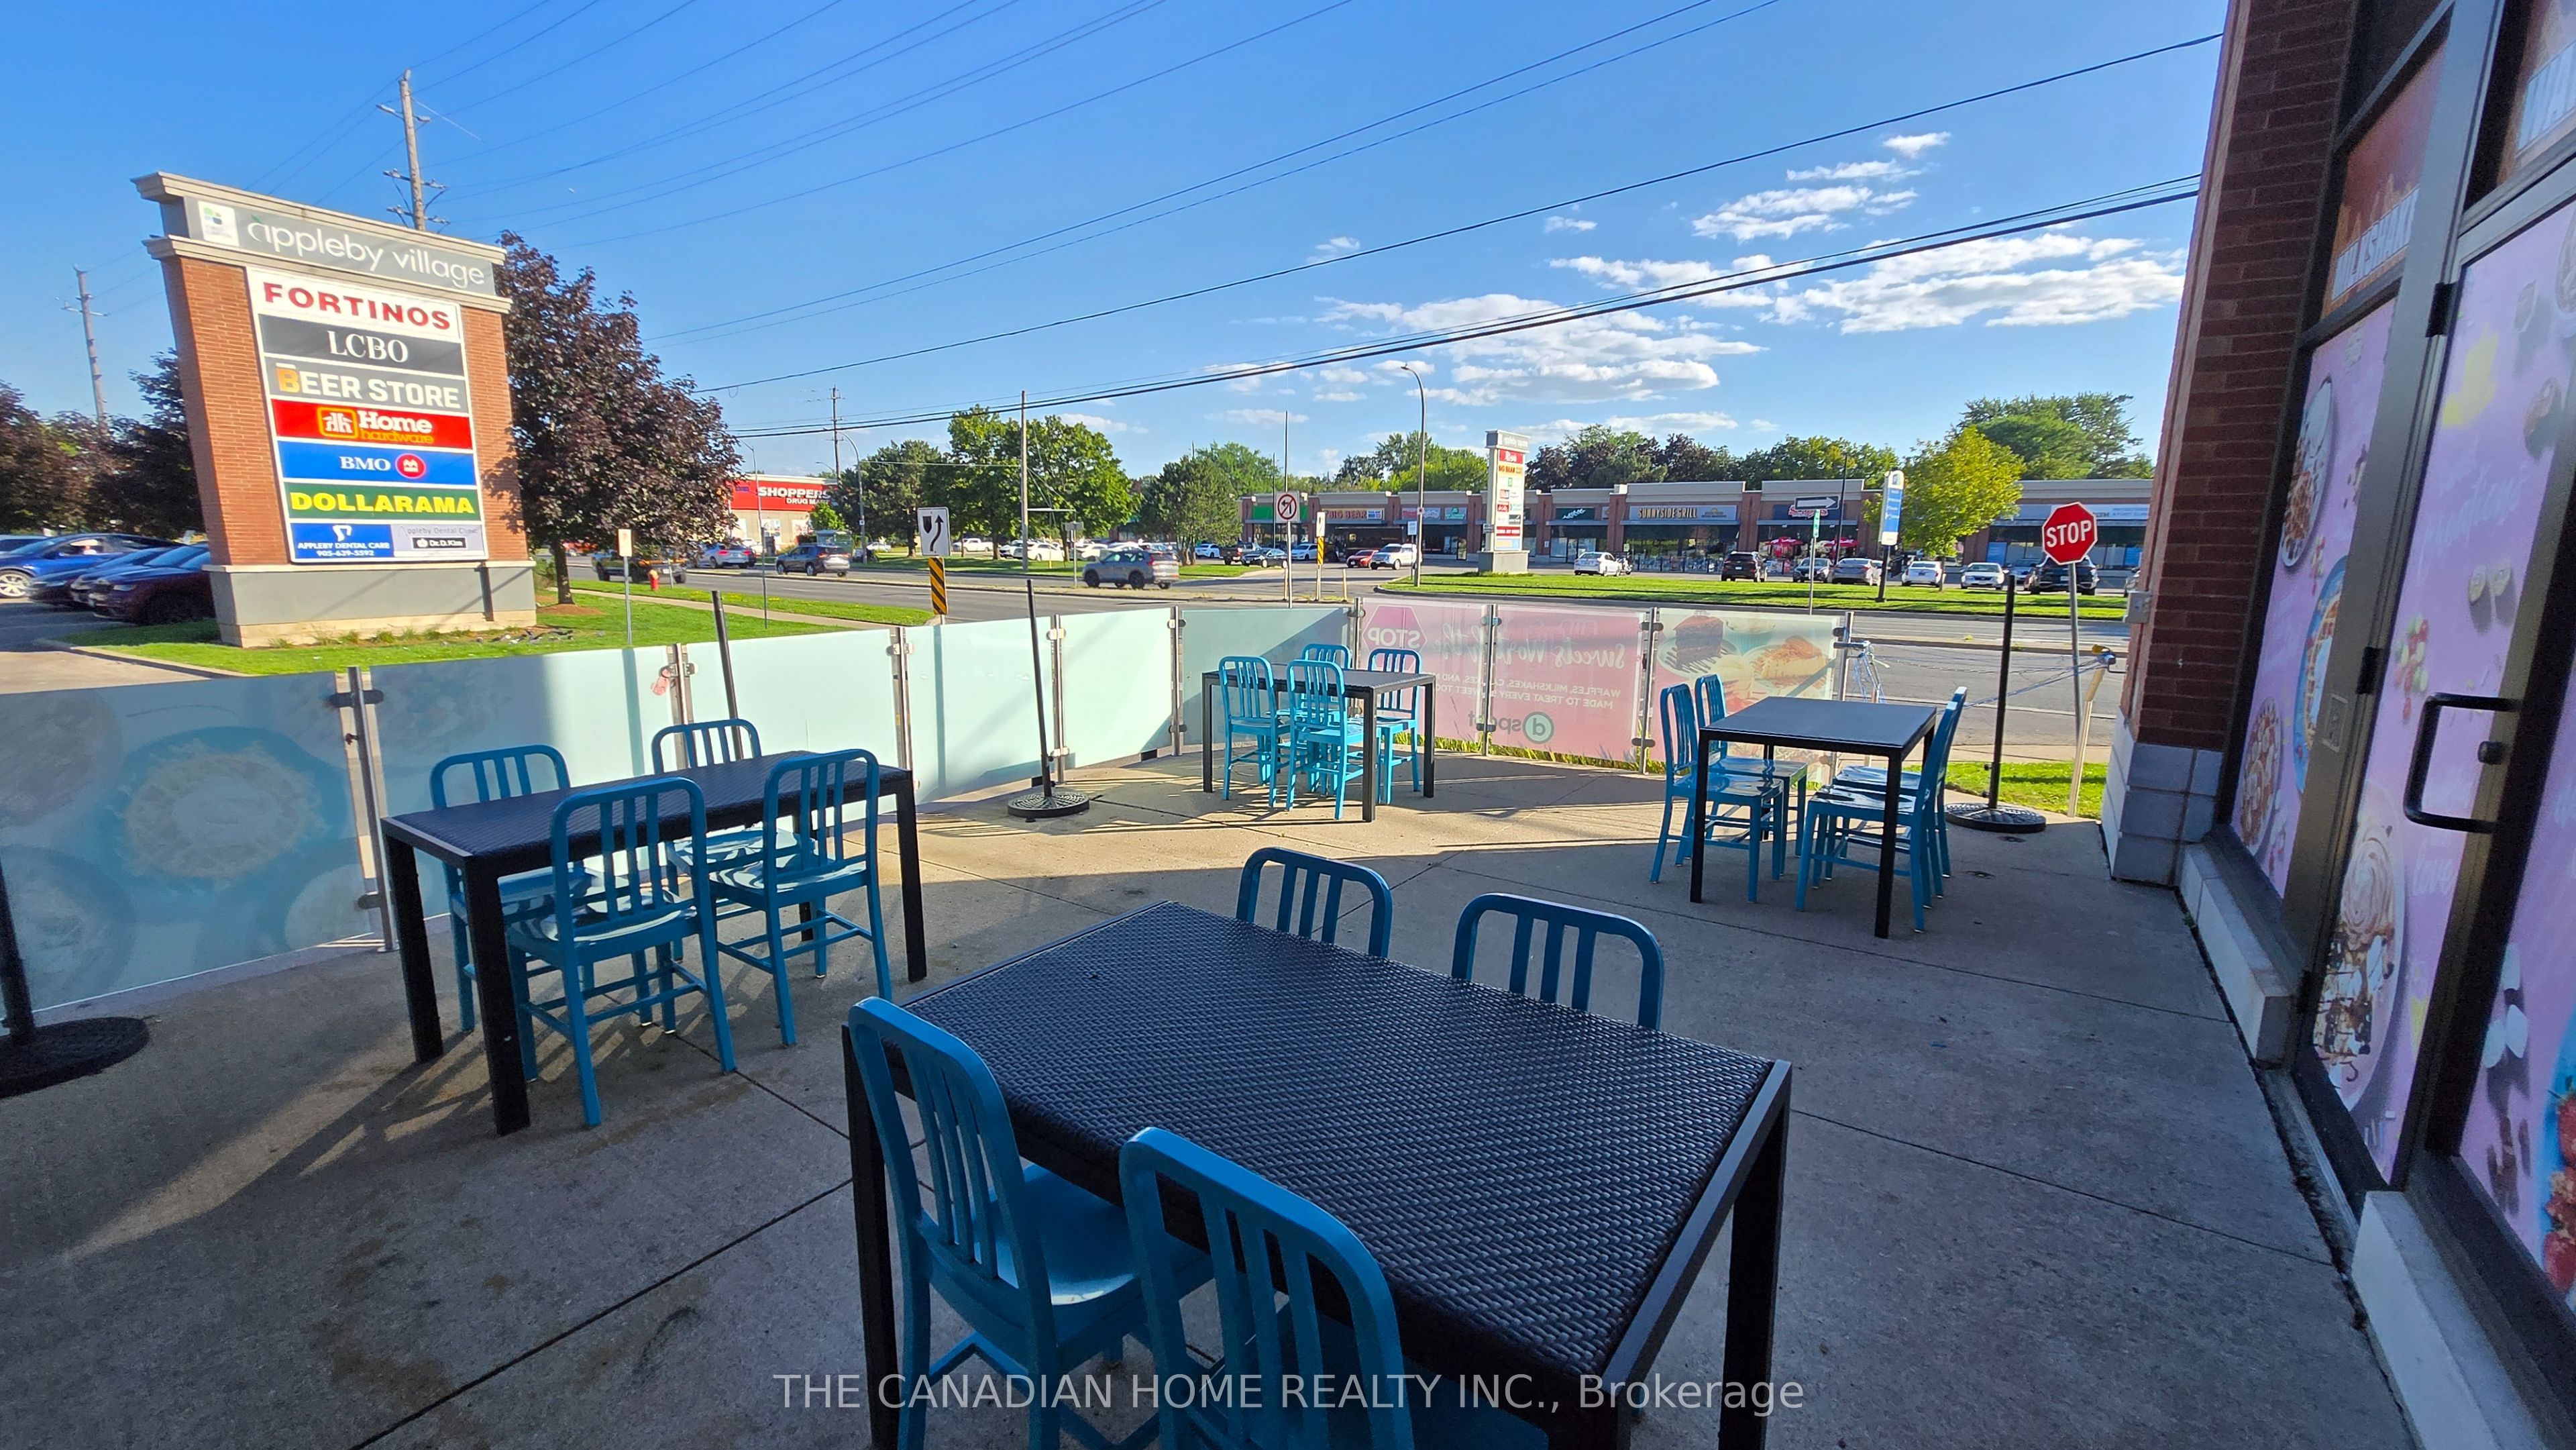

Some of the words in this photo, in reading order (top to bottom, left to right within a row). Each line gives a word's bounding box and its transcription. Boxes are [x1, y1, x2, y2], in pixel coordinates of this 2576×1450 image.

[247, 216, 384, 272] appleby
[392, 248, 485, 289] village
[263, 282, 451, 331] FORTINOS
[327, 330, 409, 363] LCBO
[275, 362, 363, 399] BEER
[368, 378, 462, 409] STORE
[357, 409, 434, 434] Home
[360, 427, 435, 444] hardware
[339, 456, 391, 472] BMO
[289, 491, 475, 514] DOLLARAMA
[1344, 510, 1366, 519] BEAR
[1638, 507, 1677, 519] SUNNYSIDE
[1677, 507, 1698, 519] GRILL
[2045, 519, 2092, 548] STOP
